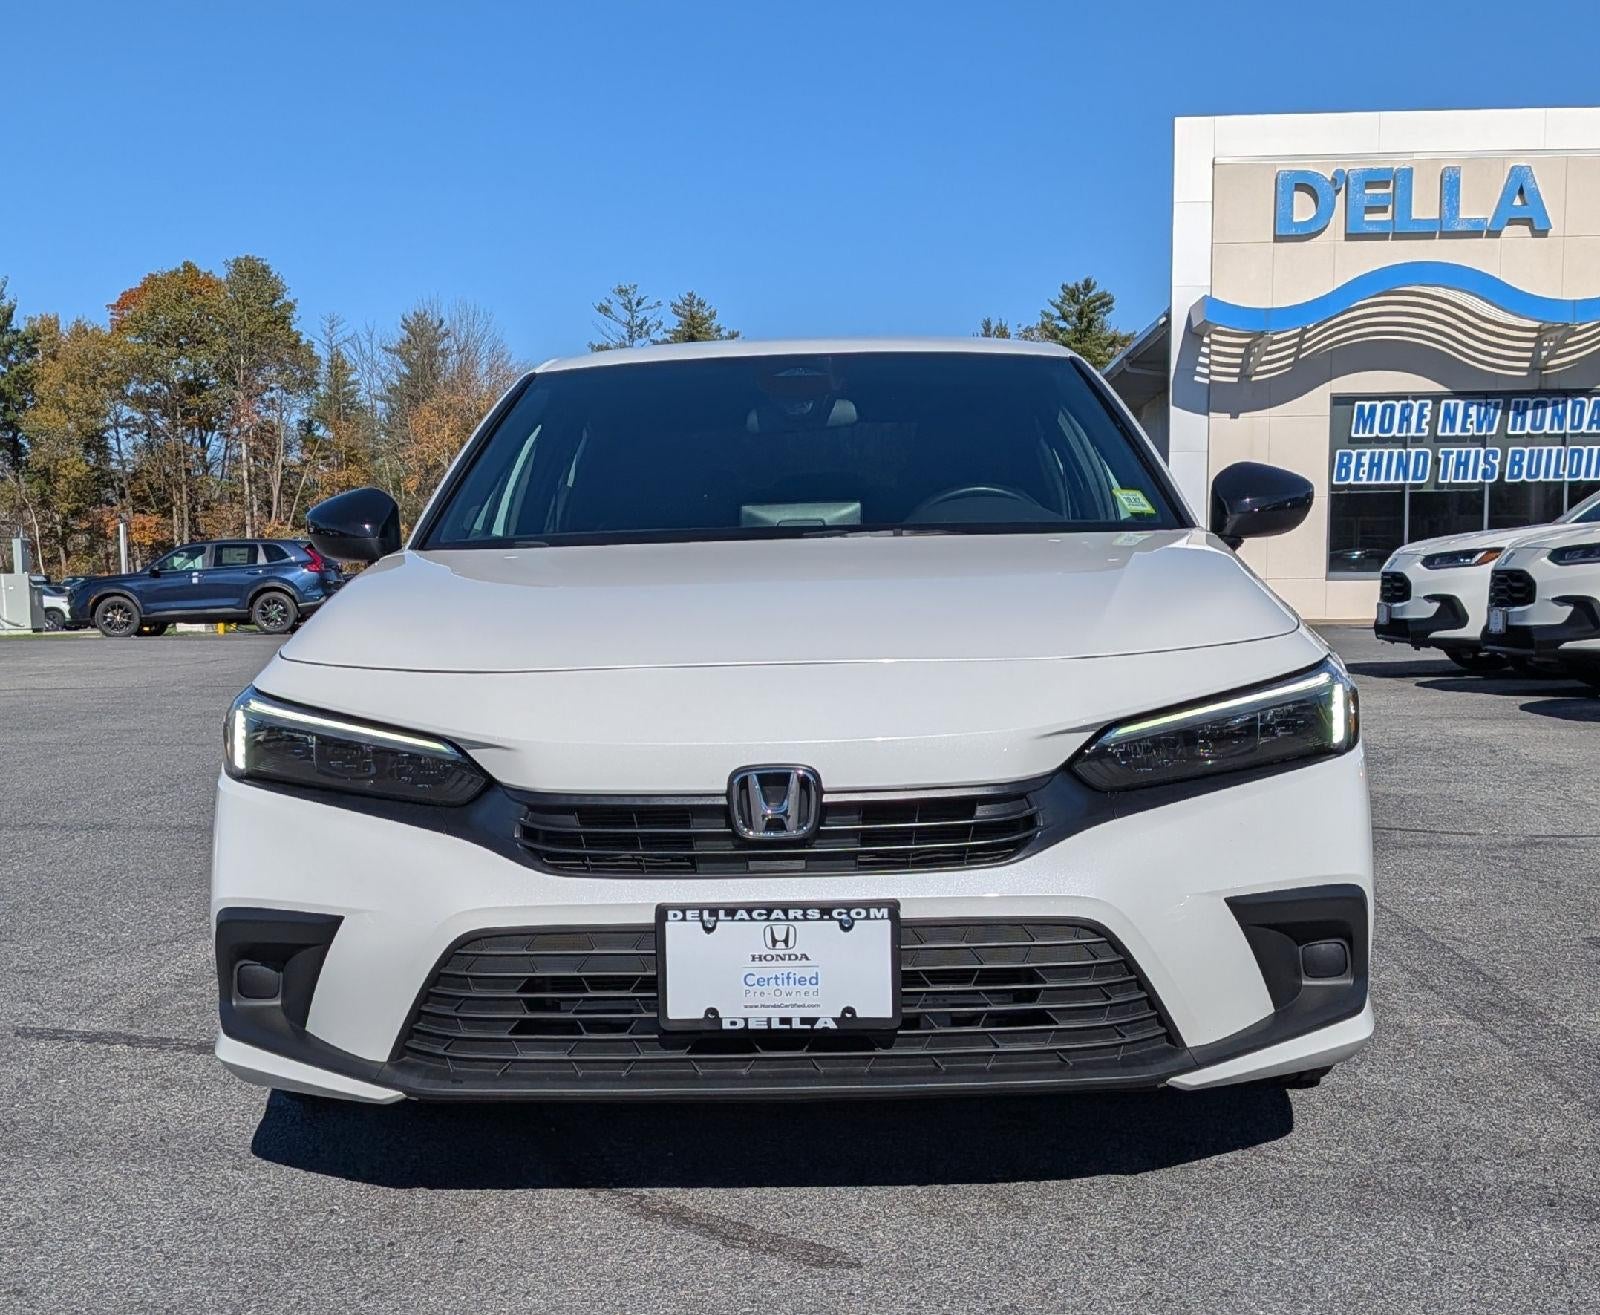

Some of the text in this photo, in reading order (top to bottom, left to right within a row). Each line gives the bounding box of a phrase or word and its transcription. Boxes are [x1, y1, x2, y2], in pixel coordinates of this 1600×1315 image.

[1275, 165, 1552, 241] D'ELLA
[1351, 400, 1432, 438] MORE
[1437, 399, 1502, 436] NEW
[1333, 446, 1600, 484] BEHIND THIS BUILDI
[667, 908, 889, 921] DELLACARS.COM
[750, 953, 811, 962] HONDA
[743, 971, 819, 987] Certified
[744, 988, 819, 998] Pre-Owned
[721, 1016, 838, 1030] DELLA
